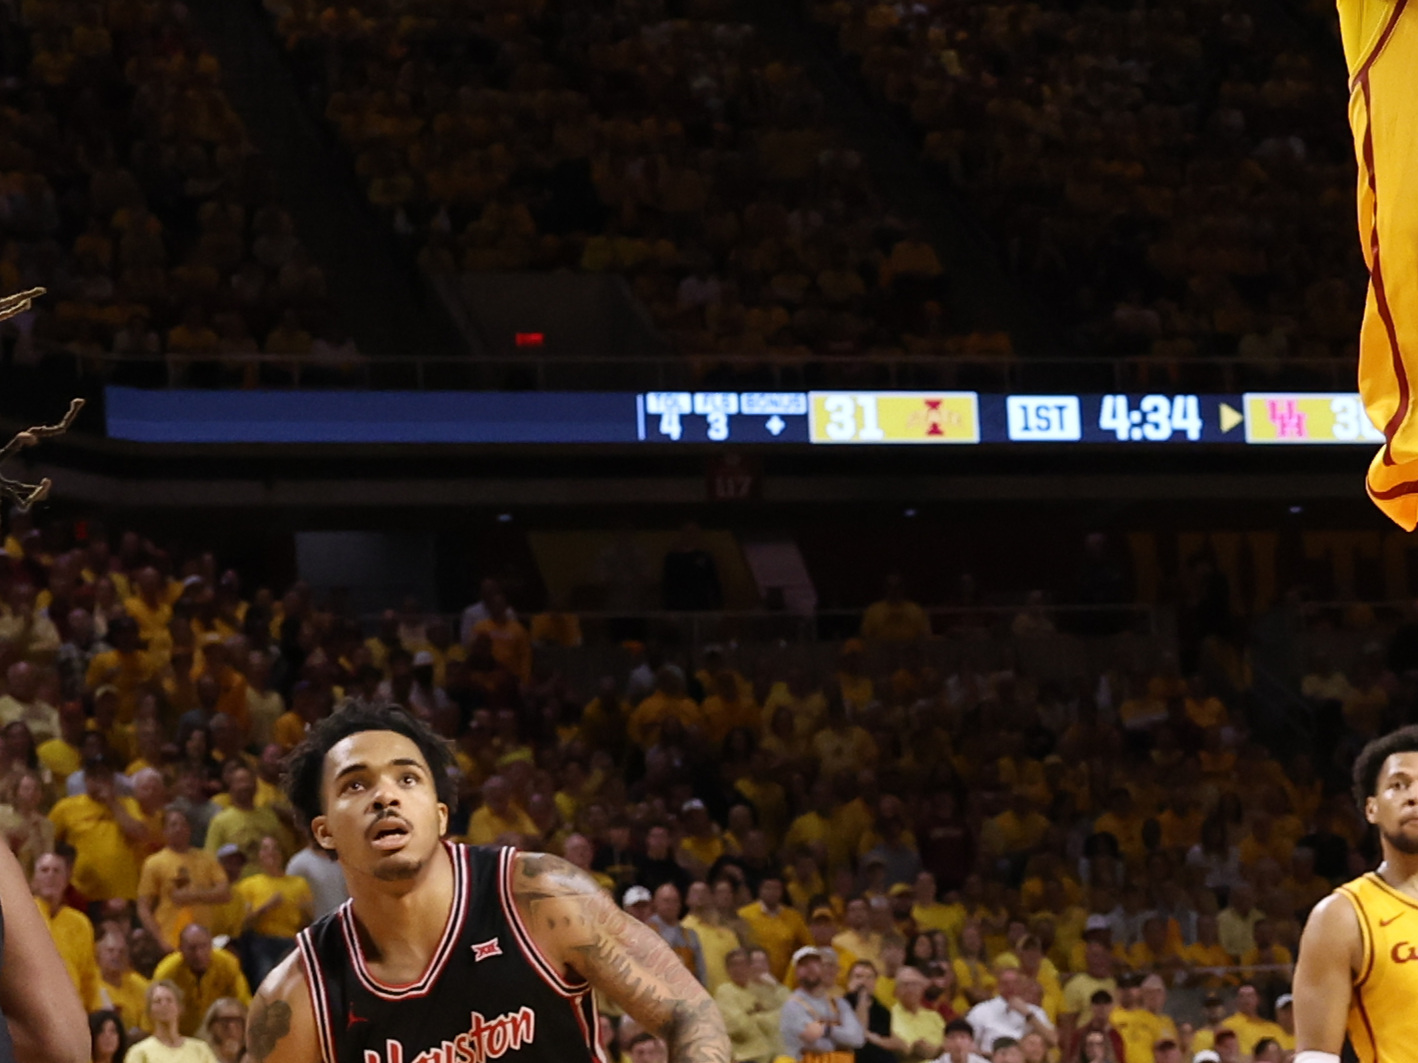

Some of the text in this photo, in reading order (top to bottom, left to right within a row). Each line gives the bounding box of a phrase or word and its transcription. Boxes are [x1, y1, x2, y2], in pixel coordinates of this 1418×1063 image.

[659, 413, 682, 441] 4
[707, 412, 729, 441] 3
[825, 395, 884, 440] 31
[1020, 394, 1201, 441] 1ST 4:34
